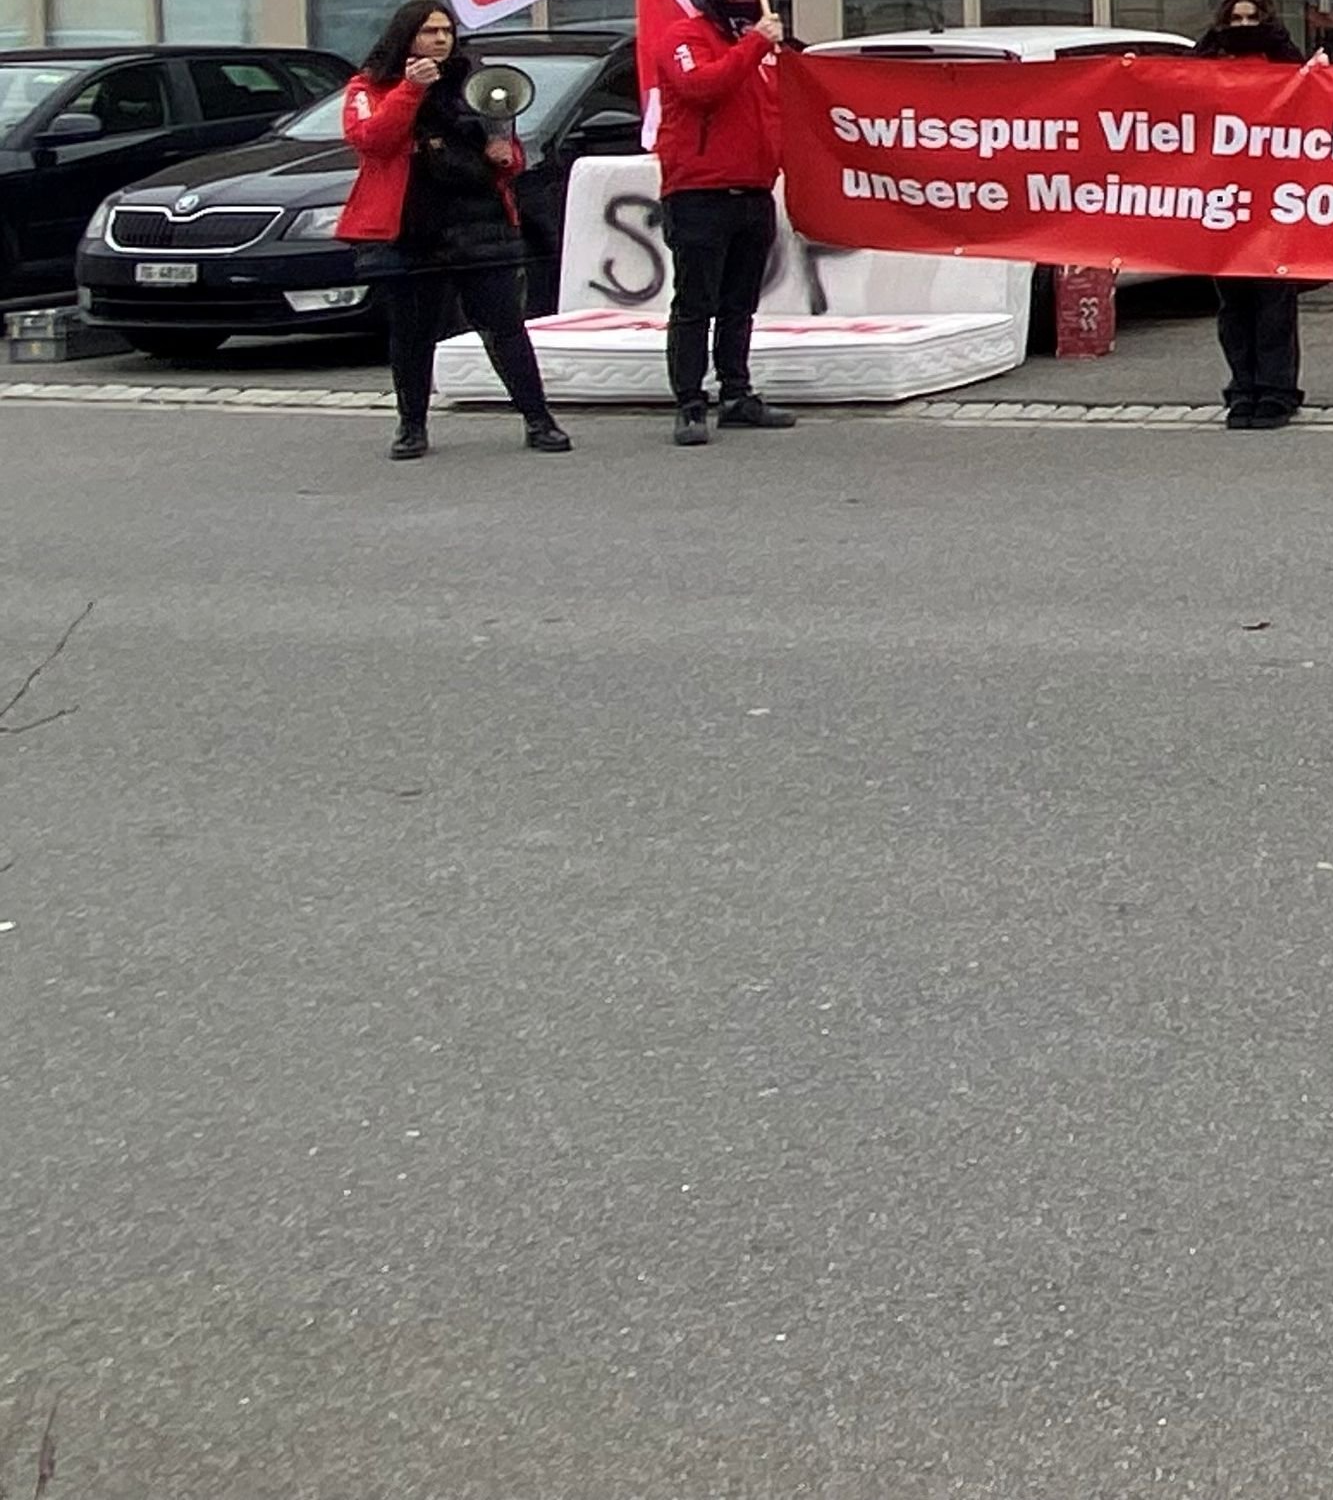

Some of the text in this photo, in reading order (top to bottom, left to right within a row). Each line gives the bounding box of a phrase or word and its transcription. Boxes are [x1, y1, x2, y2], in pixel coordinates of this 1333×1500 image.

[829, 106, 1080, 158] Swisspur:
[1098, 109, 1196, 154] Viel
[842, 167, 1009, 211] unsere
[1027, 173, 1252, 230] Meinung:
